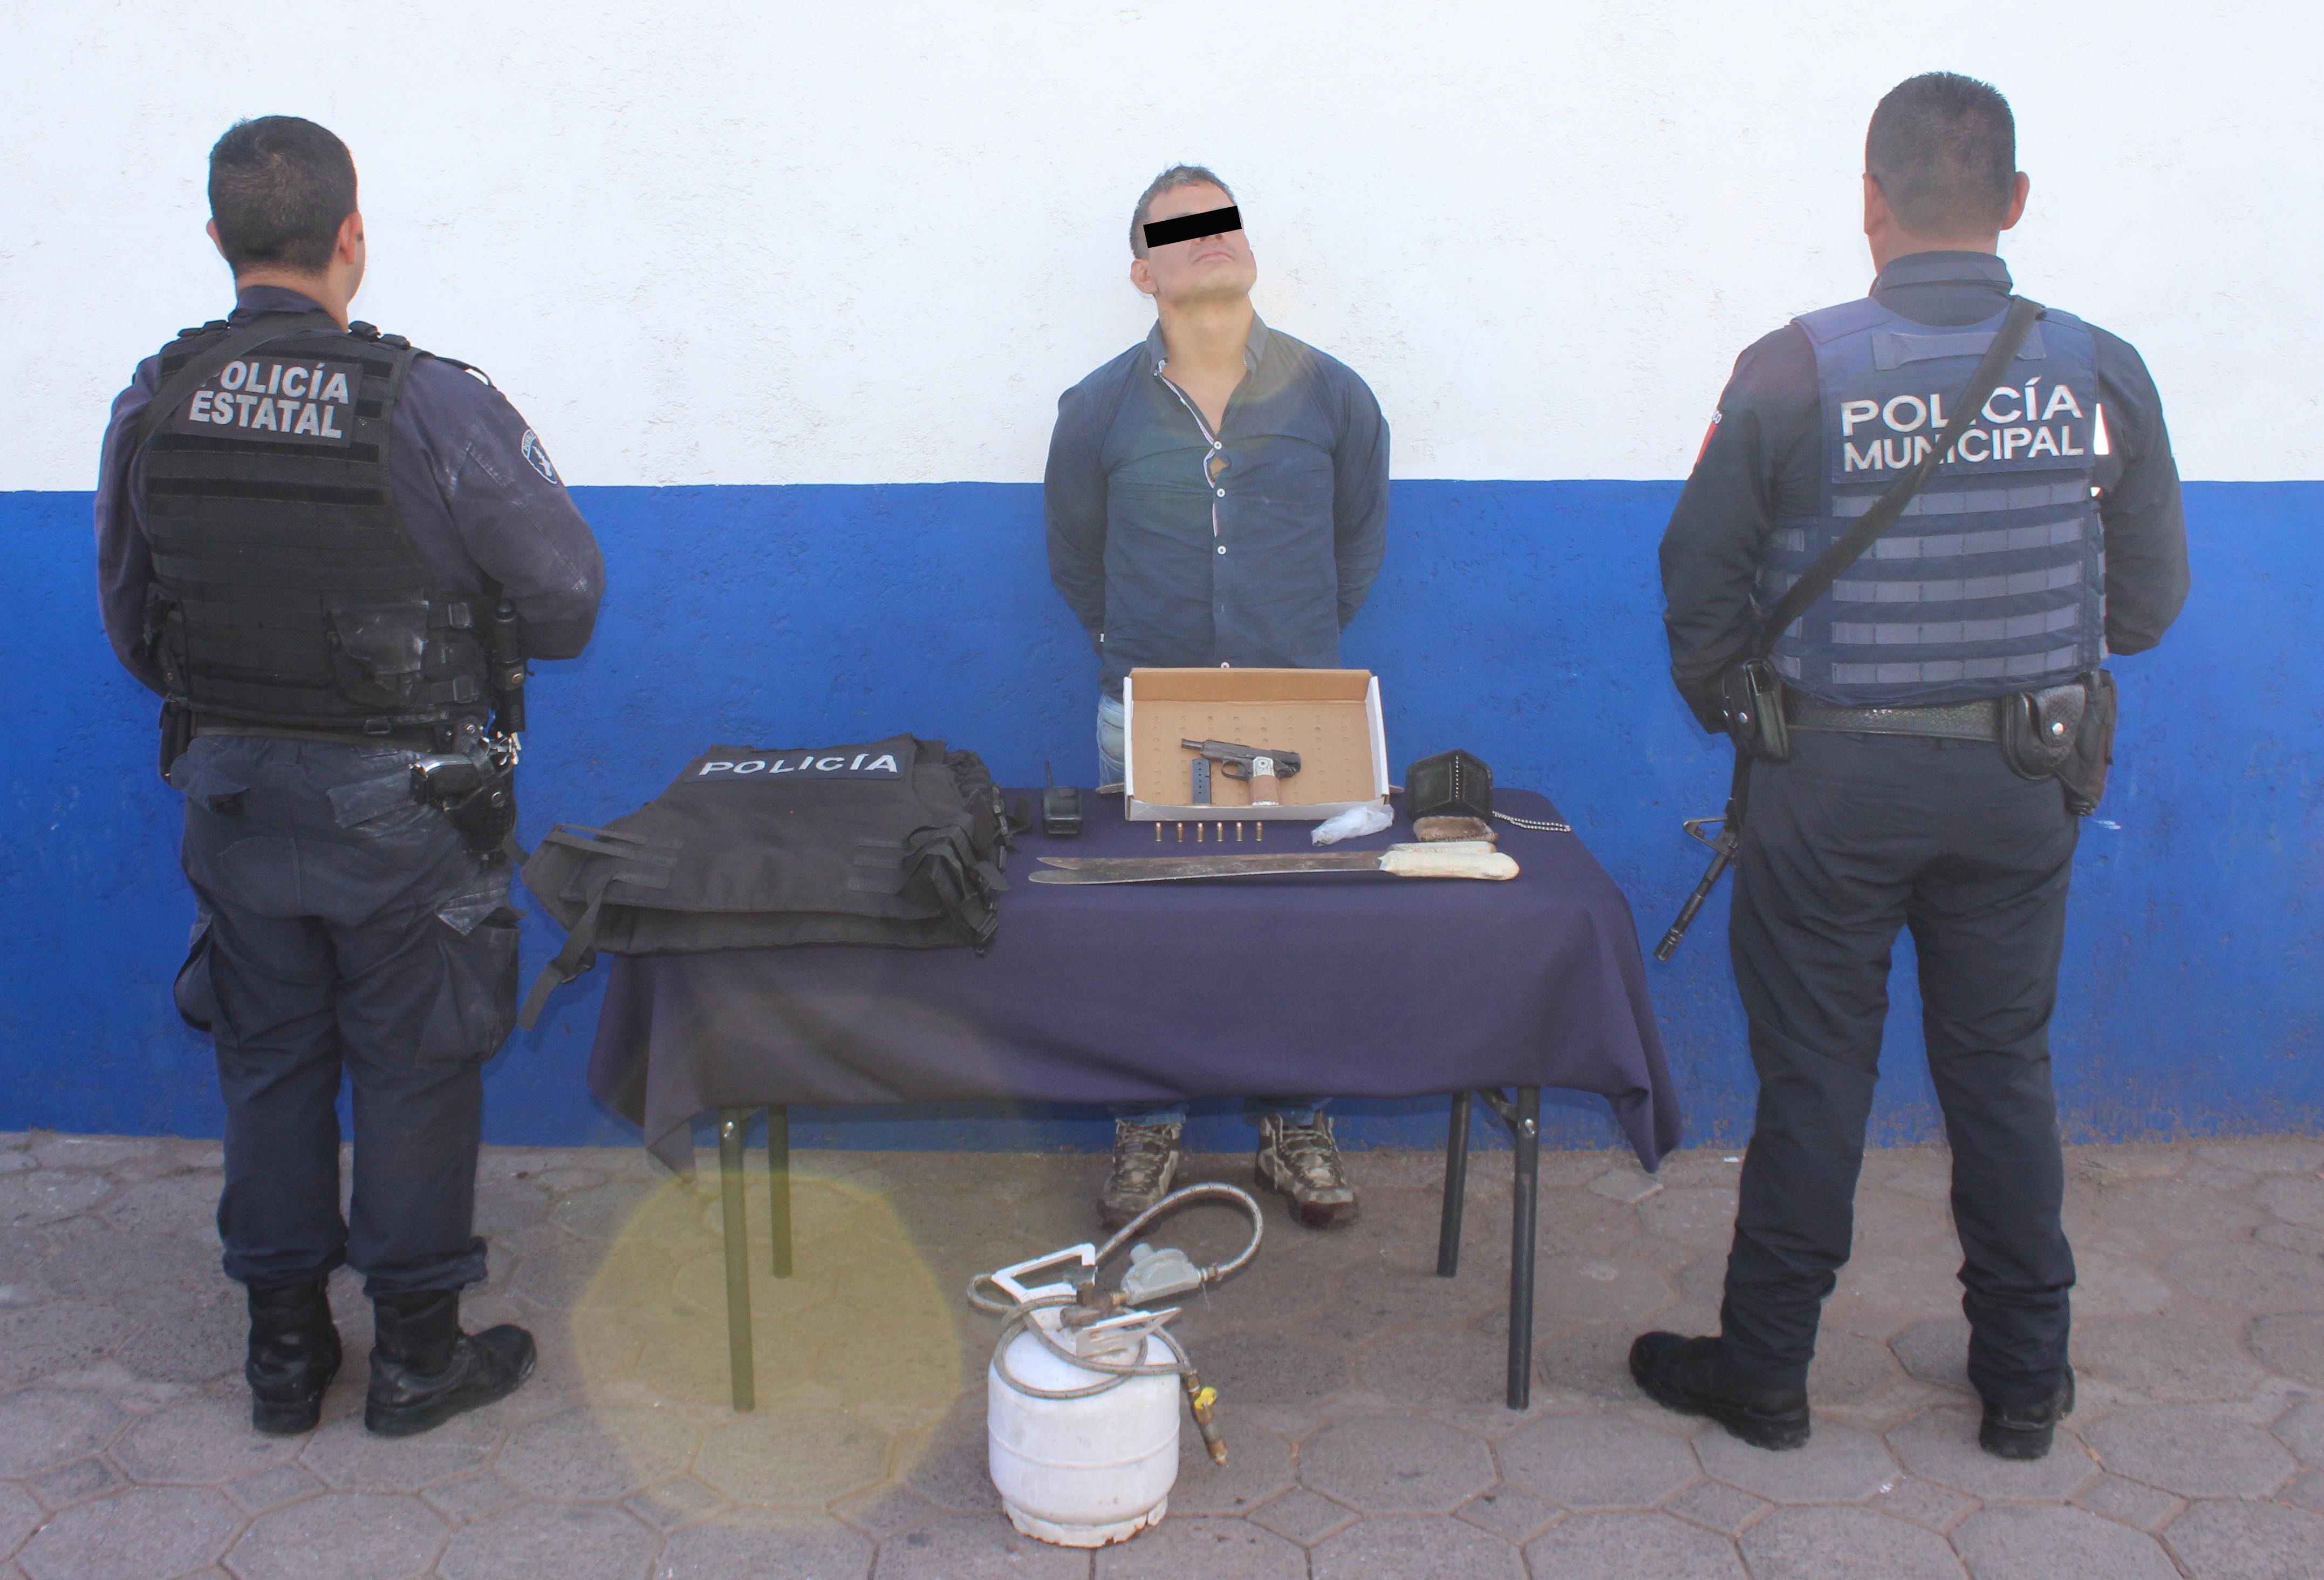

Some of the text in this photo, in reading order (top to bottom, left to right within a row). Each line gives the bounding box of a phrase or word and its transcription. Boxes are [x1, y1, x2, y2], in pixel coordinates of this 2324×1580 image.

[201, 360, 349, 404] OLICÍA
[189, 390, 343, 439] ESTATAL
[1840, 376, 2083, 437] POLCÍA
[699, 753, 898, 775] POLICÍA
